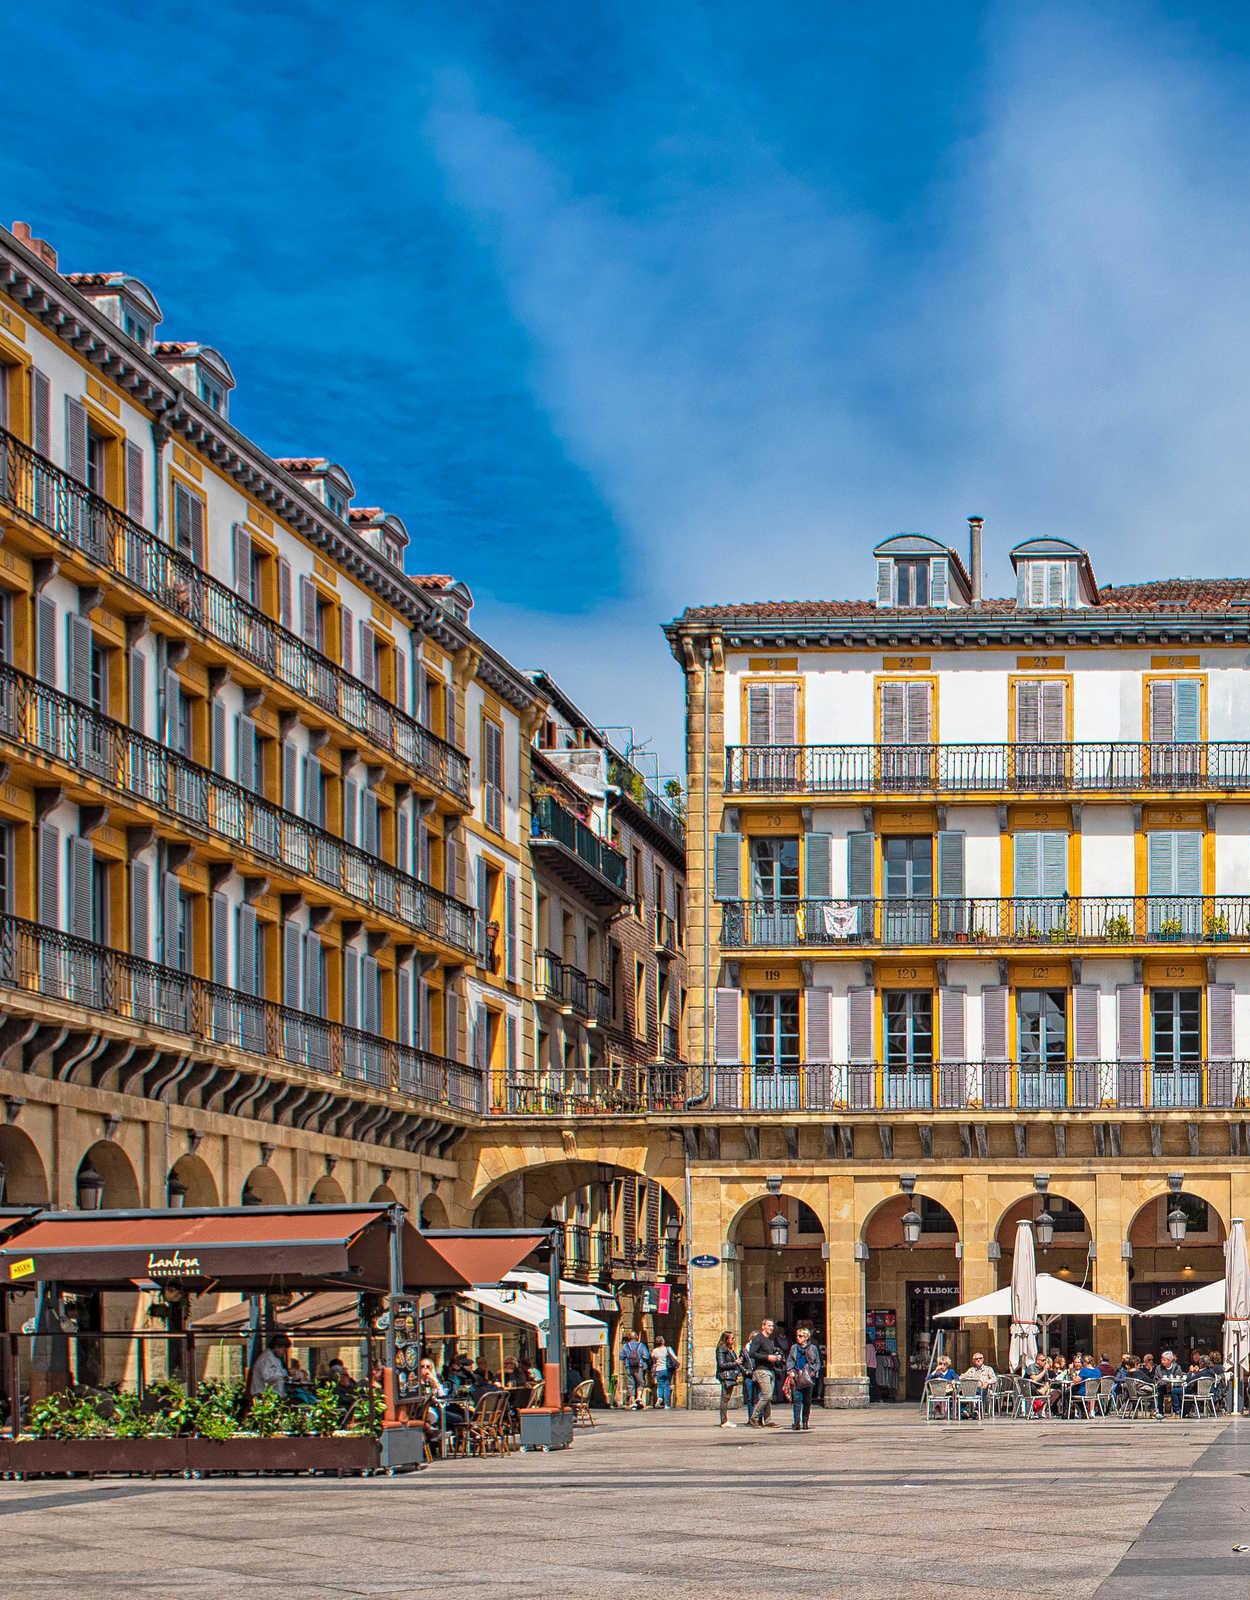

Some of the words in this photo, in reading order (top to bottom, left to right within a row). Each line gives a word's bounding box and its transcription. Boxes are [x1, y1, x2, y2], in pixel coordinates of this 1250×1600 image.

[899, 656, 913, 669] 22
[767, 815, 781, 826] 70
[765, 970, 780, 980] 119
